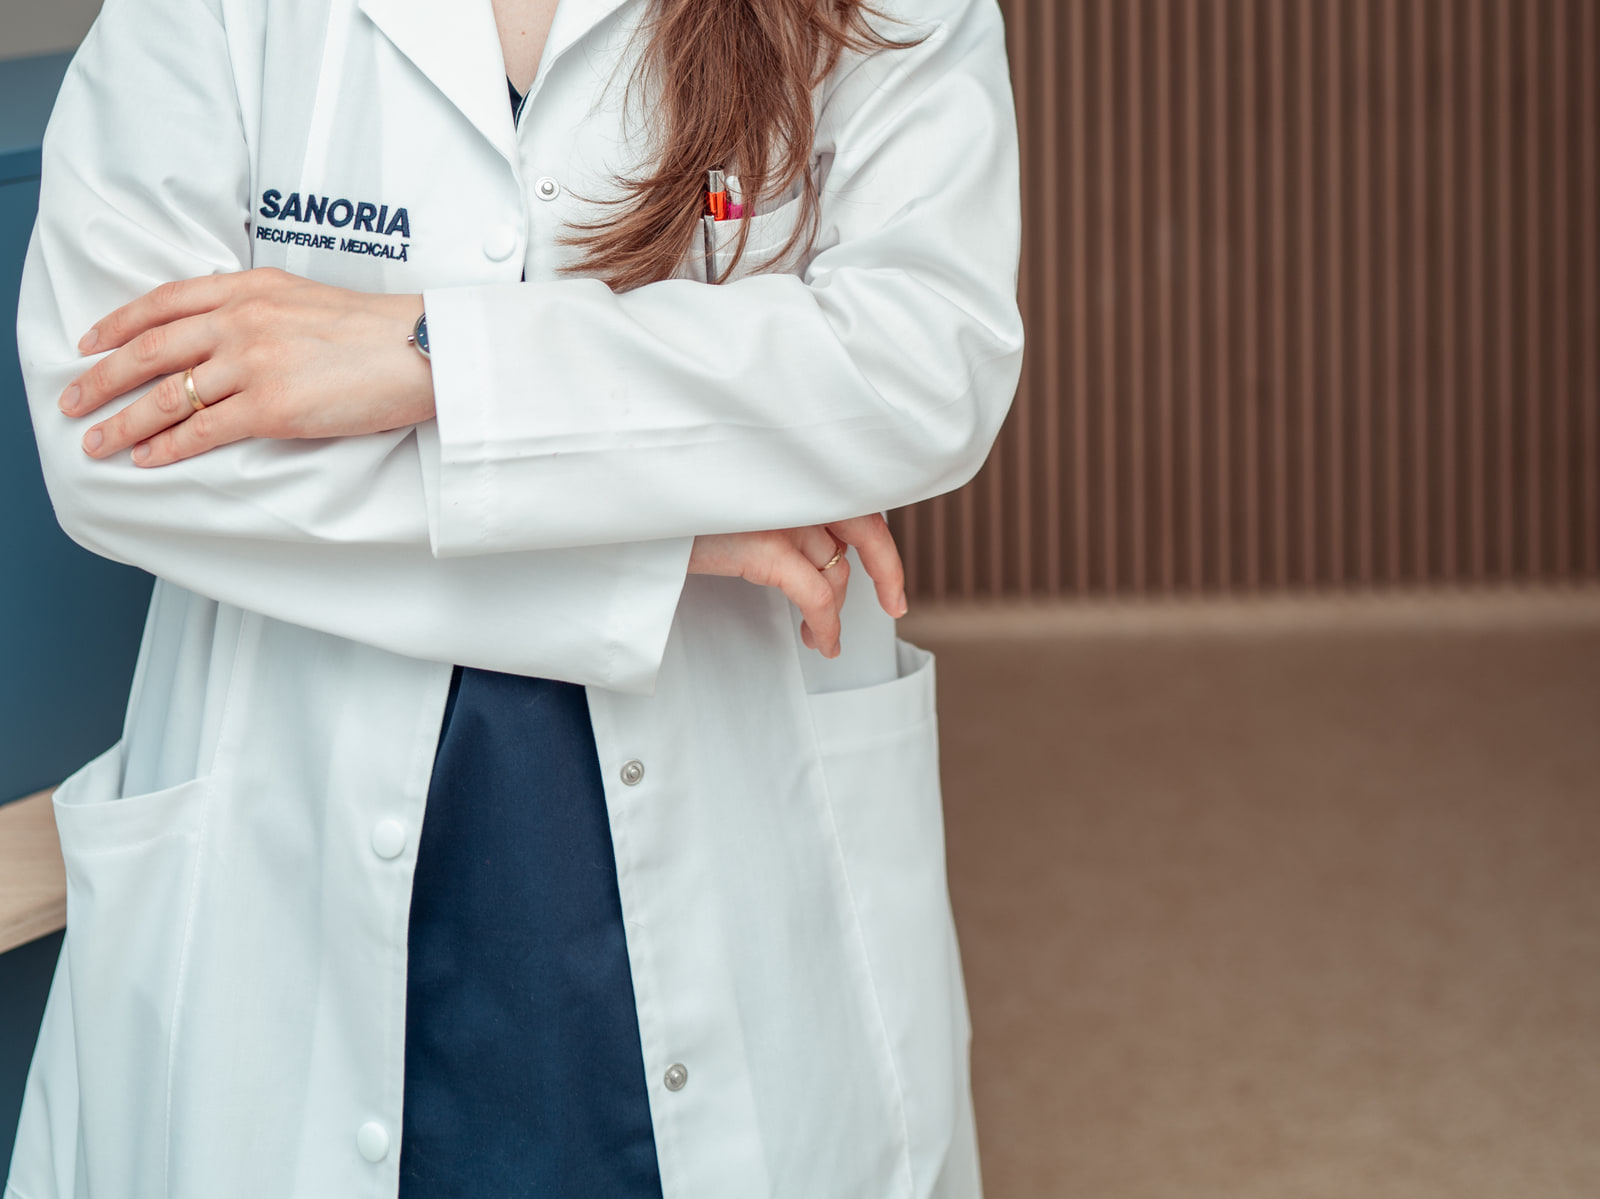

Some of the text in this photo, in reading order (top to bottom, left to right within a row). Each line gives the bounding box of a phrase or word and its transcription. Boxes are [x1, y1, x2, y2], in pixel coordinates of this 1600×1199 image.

[259, 188, 411, 239] SANORIA
[256, 226, 410, 263] RECUPERARE MEDICALĂ
